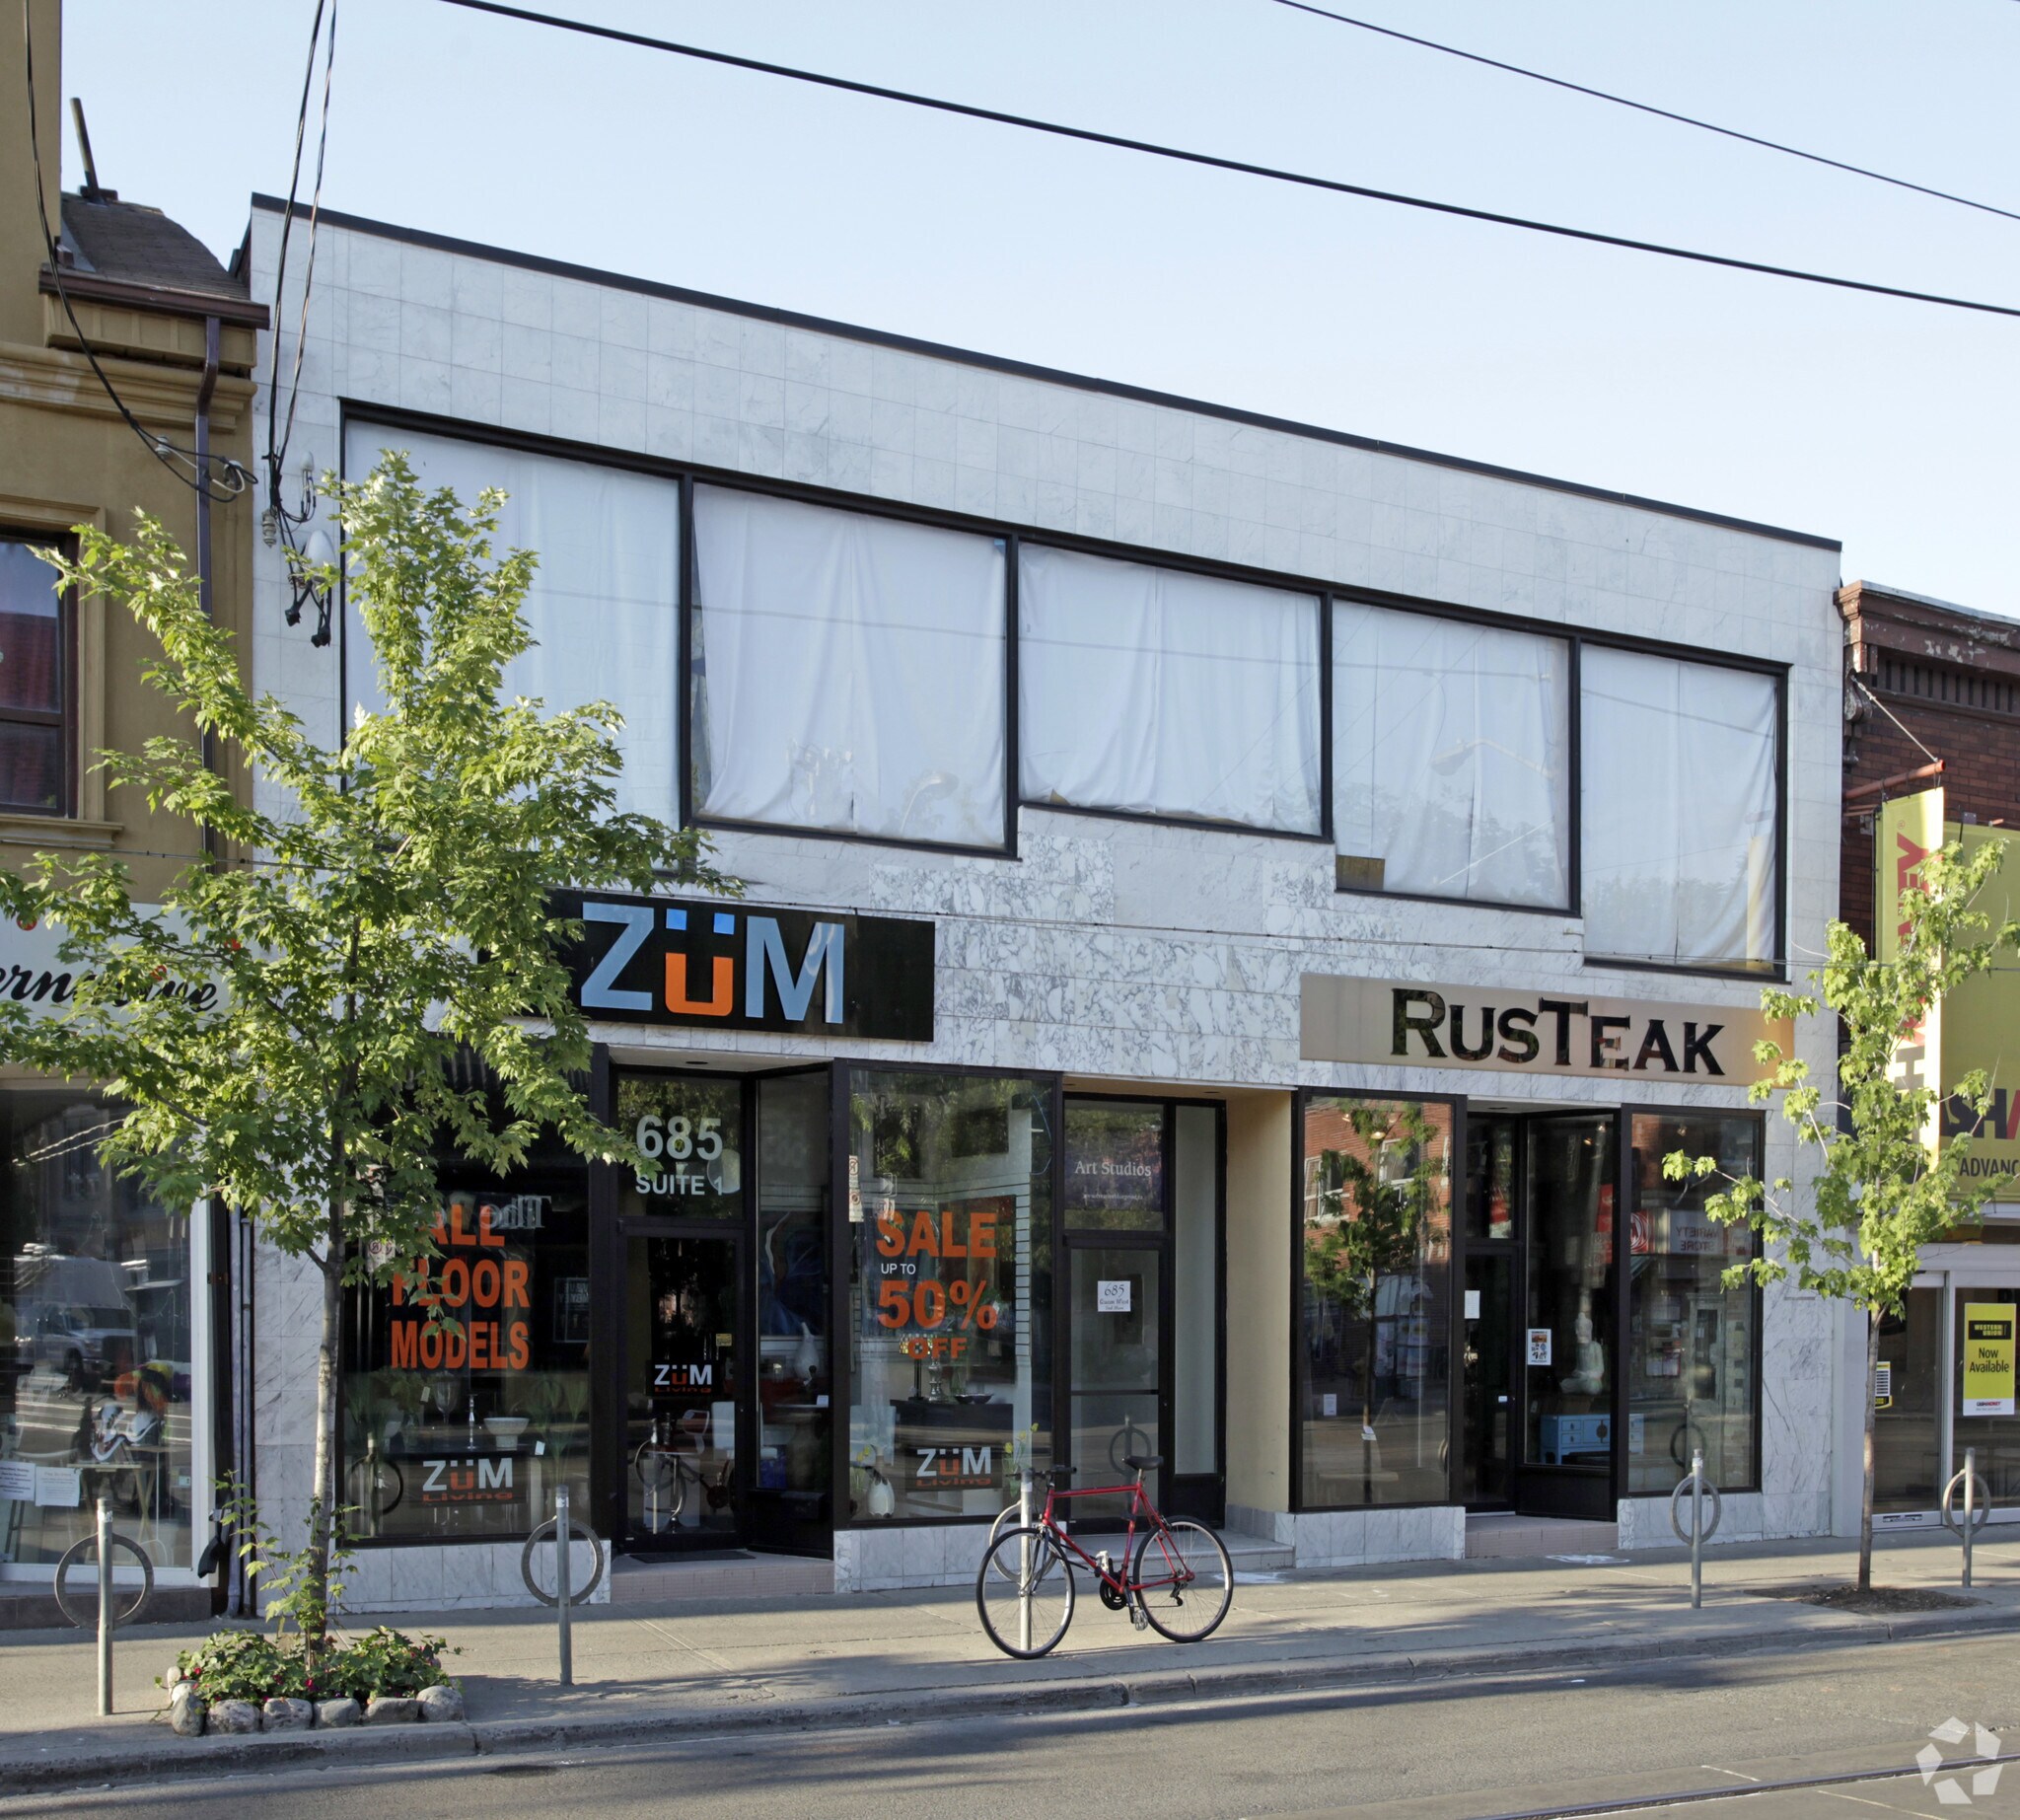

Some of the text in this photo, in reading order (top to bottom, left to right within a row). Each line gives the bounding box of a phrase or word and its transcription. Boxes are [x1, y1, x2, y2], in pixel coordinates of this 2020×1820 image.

[1391, 988, 1726, 1075] RUSTEAK
[635, 1115, 723, 1160] 685
[1074, 1160, 1152, 1177] Art Studios
[635, 1174, 705, 1197] SUITE
[876, 1210, 997, 1258] SALE
[881, 1263, 916, 1275] UP TO
[392, 1258, 531, 1308] FLOOR
[1105, 1282, 1124, 1297] 685
[877, 1279, 998, 1330] 50%
[391, 1320, 531, 1370] MODELS
[907, 1337, 968, 1359] OFF
[1979, 1347, 1998, 1359] Now
[1969, 1360, 2010, 1373] Available
